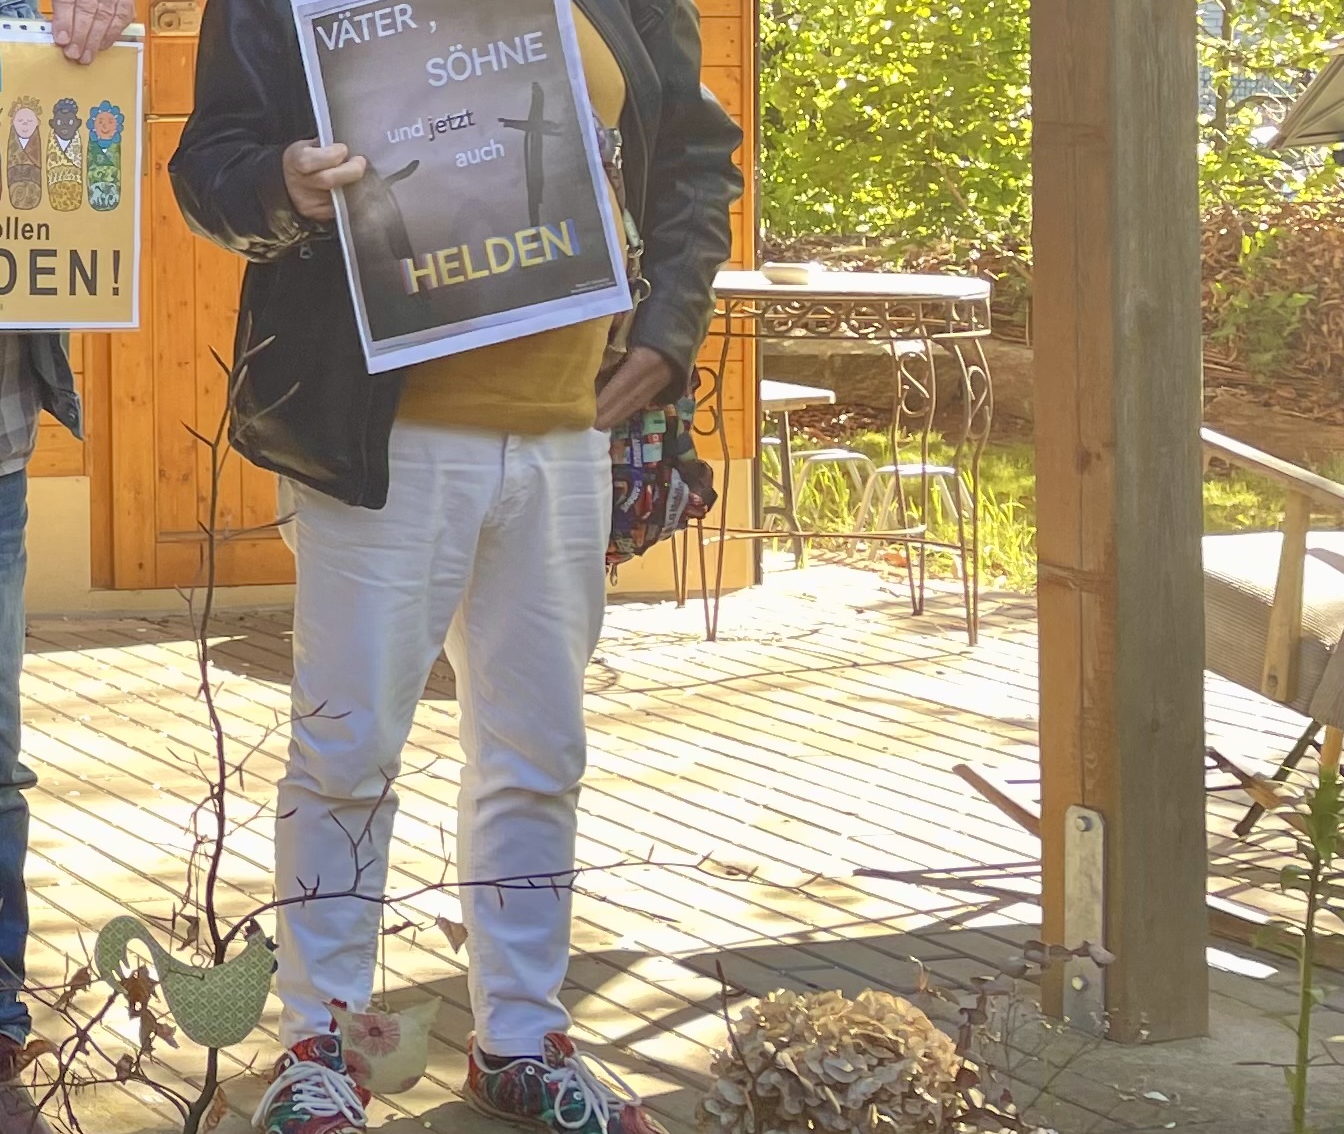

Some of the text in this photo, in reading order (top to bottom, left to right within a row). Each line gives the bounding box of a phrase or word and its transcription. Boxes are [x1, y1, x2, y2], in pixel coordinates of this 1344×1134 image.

[426, 32, 547, 87] SÖHNE
[386, 108, 476, 145] und jetzt
[455, 139, 505, 167] auch
[402, 218, 578, 295] HELDEN
